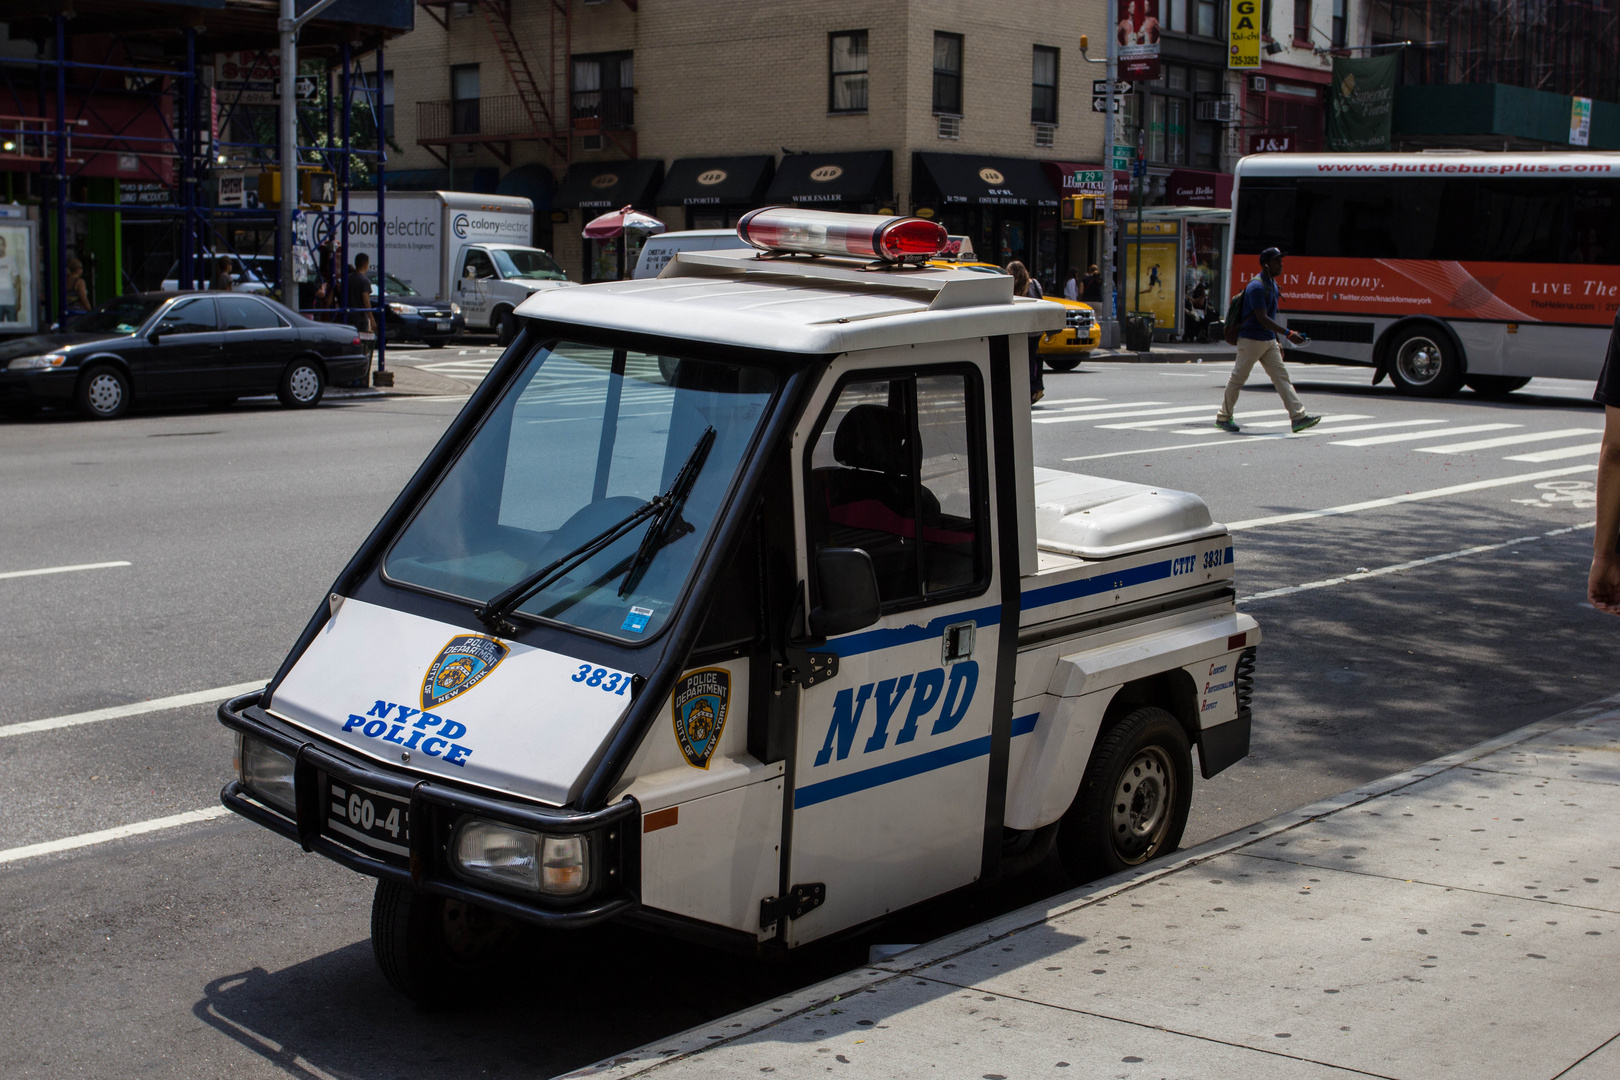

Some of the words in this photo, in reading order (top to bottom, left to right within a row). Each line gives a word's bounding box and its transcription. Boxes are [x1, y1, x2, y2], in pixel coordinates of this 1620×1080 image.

[1231, 32, 1260, 41] Tai-chi
[1231, 55, 1259, 65] 725-3262
[1362, 102, 1390, 117] Florist
[1256, 138, 1289, 152] J&J
[1076, 173, 1083, 181] W
[1085, 172, 1096, 182] 29
[1317, 163, 1611, 175] www.shuttlebusplus.com
[792, 194, 842, 202] WHOLESALER
[1195, 186, 1214, 195] Bella
[1283, 274, 1299, 285] IN
[1307, 272, 1385, 291] harmony.
[1531, 282, 1573, 295] LIVE
[1583, 280, 1618, 297] The
[1339, 293, 1432, 305] Twitter.com/knackfornewyork
[1530, 299, 1595, 311] TheHelena.com
[1173, 554, 1196, 576] CTTF
[1203, 548, 1223, 569] 3831
[464, 638, 498, 653] POLICE
[443, 645, 498, 667] DEPARTMENT
[427, 662, 441, 682] CITY
[462, 670, 489, 689] YORK
[571, 664, 632, 696] 3831
[424, 684, 432, 694] OF
[687, 673, 718, 689] POLICE
[438, 689, 460, 703] NEW
[676, 683, 727, 708] DEPARTMENT
[365, 699, 468, 740] NYPD
[813, 660, 980, 768] NYPD
[676, 719, 687, 743] CITY
[684, 744, 694, 756] OF
[703, 737, 717, 758] NEW
[715, 703, 726, 731] YORK
[341, 714, 473, 767] POLICE
[348, 793, 400, 838] GO-4
